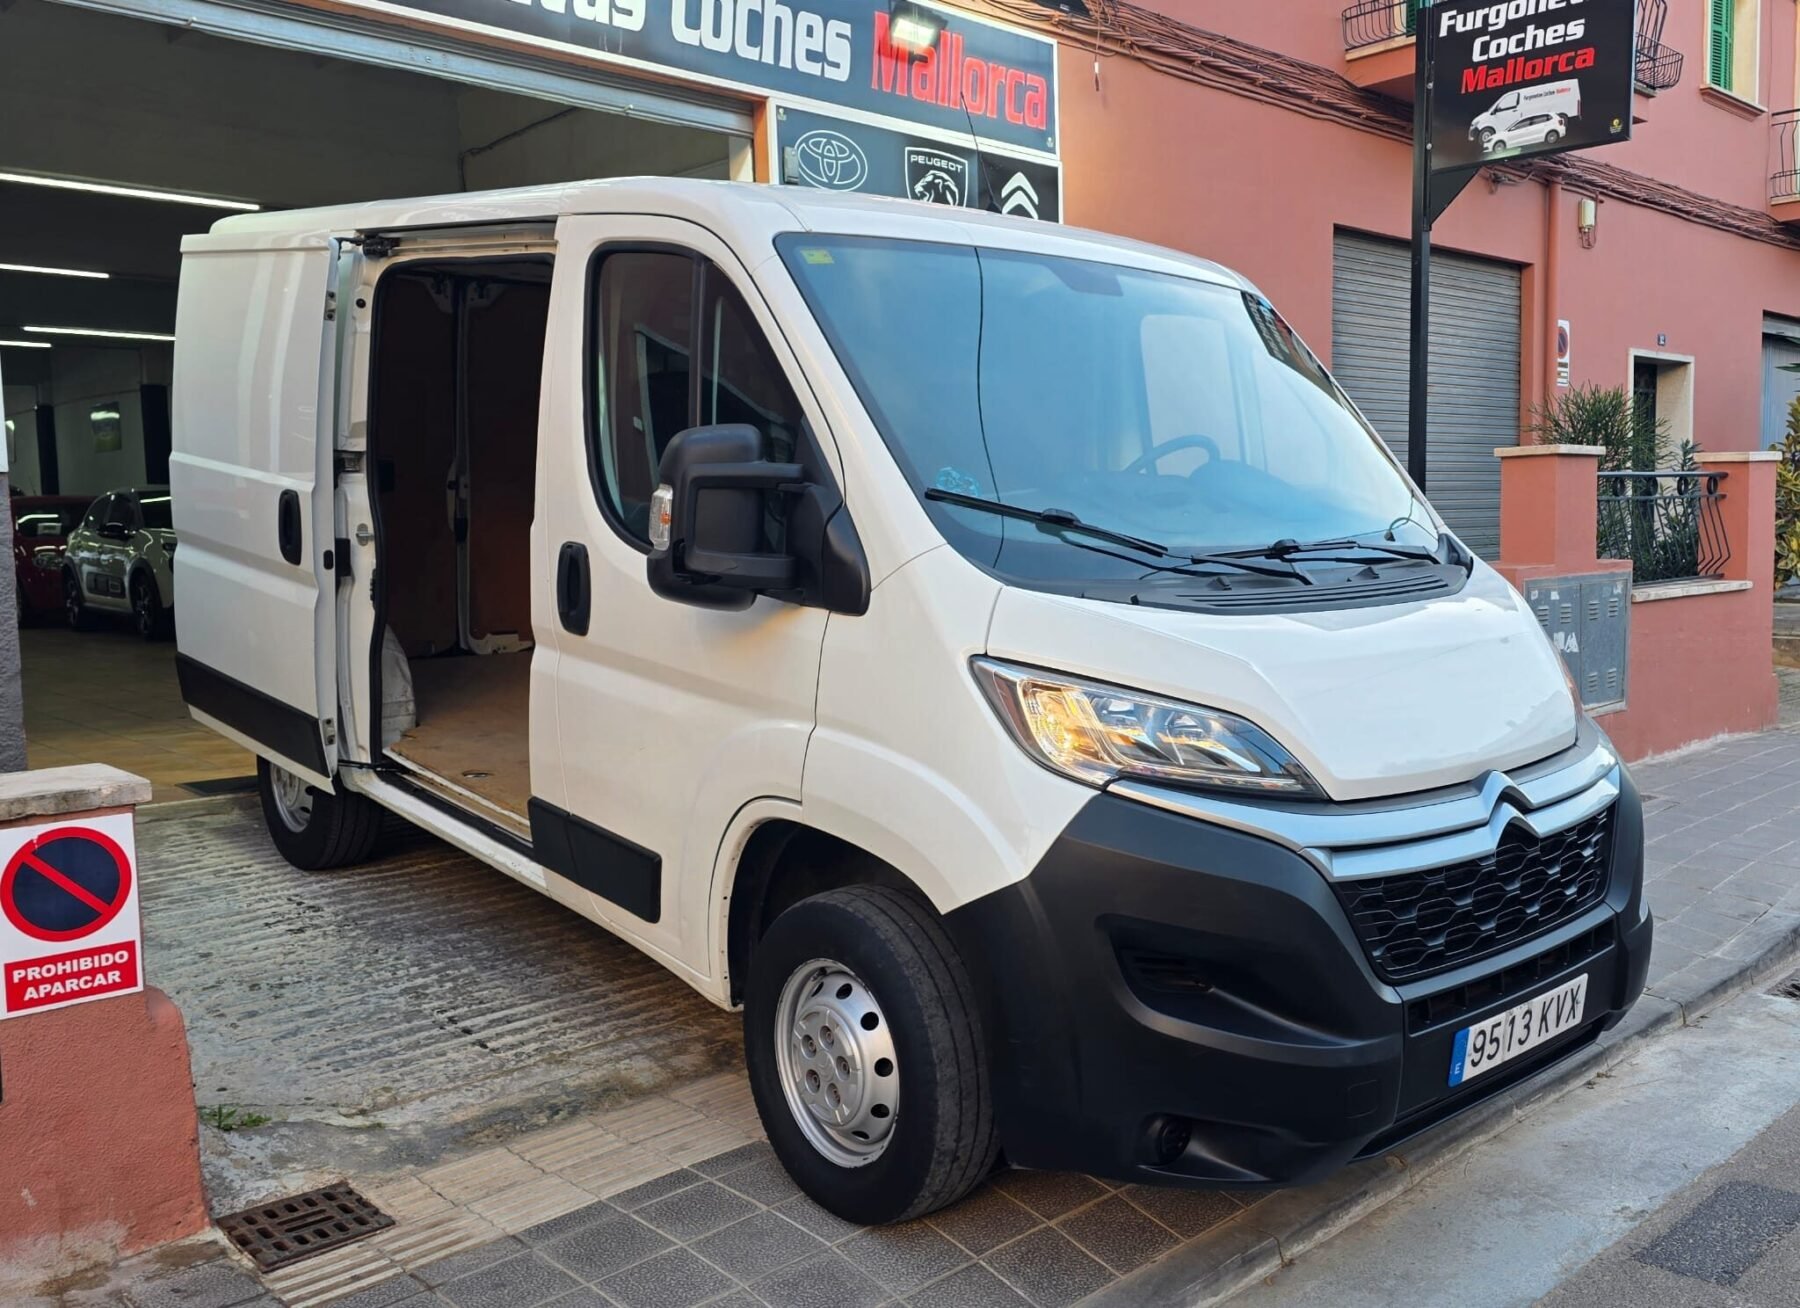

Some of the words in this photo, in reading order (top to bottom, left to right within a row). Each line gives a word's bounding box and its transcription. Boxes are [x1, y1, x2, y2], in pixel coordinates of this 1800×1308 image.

[1472, 18, 1586, 62] Coches
[871, 11, 1048, 130] Mallorca
[1461, 47, 1596, 94] Mallorca
[910, 154, 963, 173] PEUGEOT
[12, 950, 129, 983] PROHIBIDO
[23, 970, 122, 1001] APARCAR
[1470, 1009, 1532, 1068] 9513
[1538, 984, 1581, 1038] KVX
[1454, 1062, 1462, 1074] E
